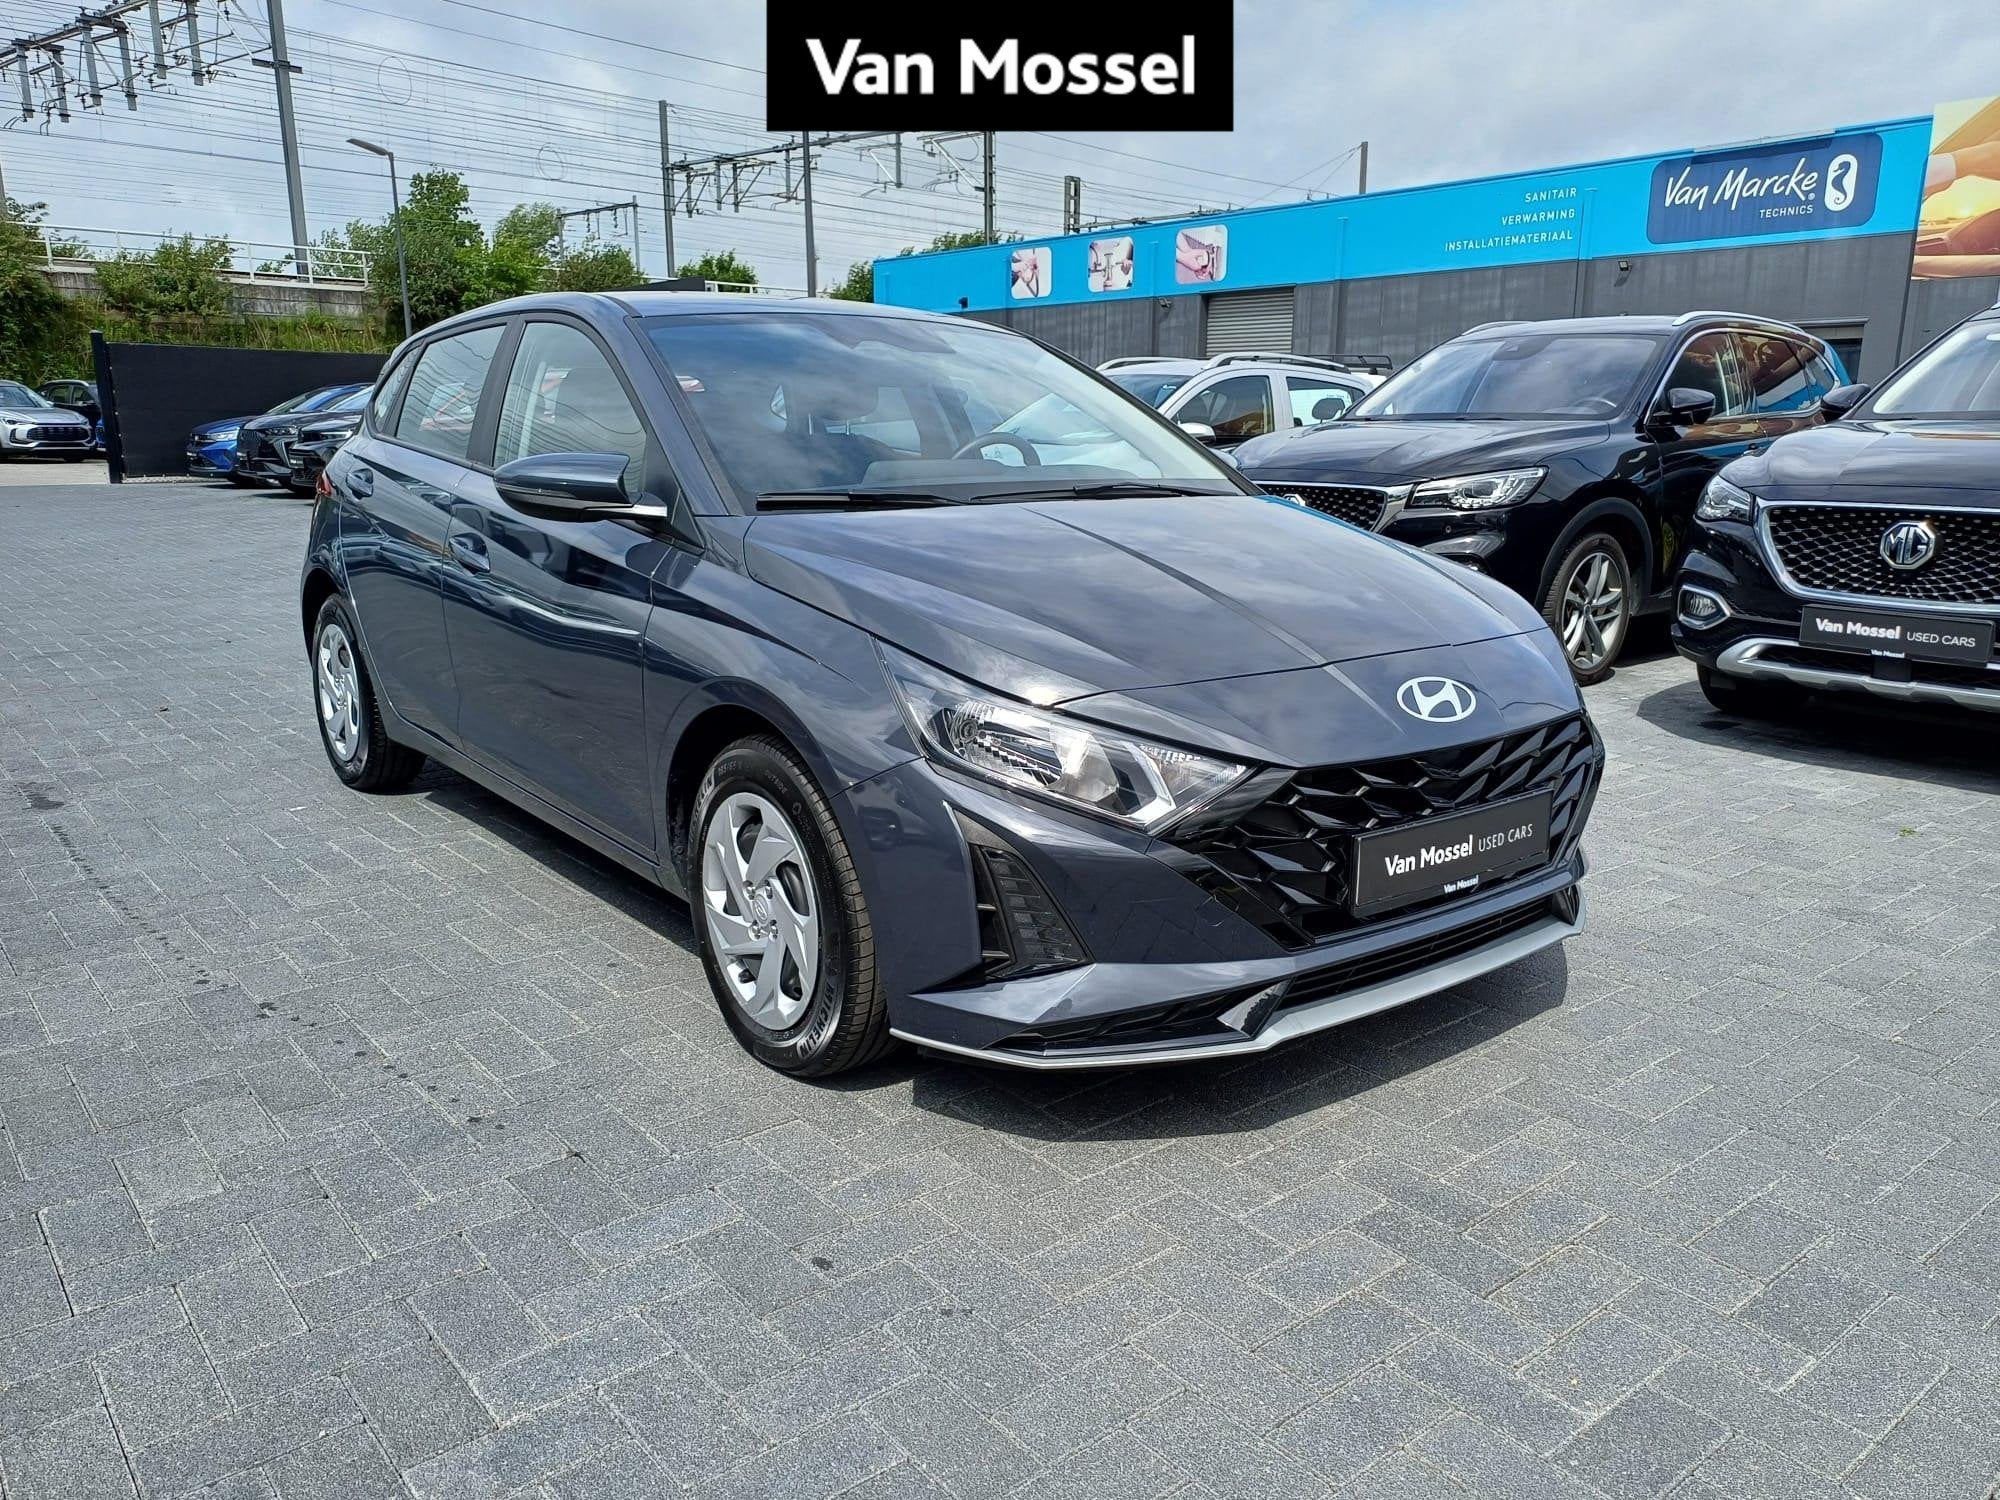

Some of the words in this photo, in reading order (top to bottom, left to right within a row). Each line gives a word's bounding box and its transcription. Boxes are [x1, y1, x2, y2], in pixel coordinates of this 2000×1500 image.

[1525, 187, 1577, 203] SANITAIR
[1664, 166, 1709, 211] Van
[1712, 157, 1818, 211] Marcke
[1501, 208, 1575, 226] VERWARMING
[1759, 204, 1814, 219] TECHNICS
[1444, 230, 1573, 252] INSTALLATIEMATERIAAL
[1885, 524, 1929, 565] MG
[1815, 617, 1843, 634] Van
[1846, 621, 1900, 640] Mossel
[1906, 631, 1939, 644] USED
[1941, 634, 1976, 648] CARS
[1384, 854, 1416, 877] Van
[1420, 834, 1473, 868] Mossel
[1478, 832, 1504, 852] USED
[1507, 823, 1533, 843] CARS
[799, 981, 836, 1059] MICHELIN
